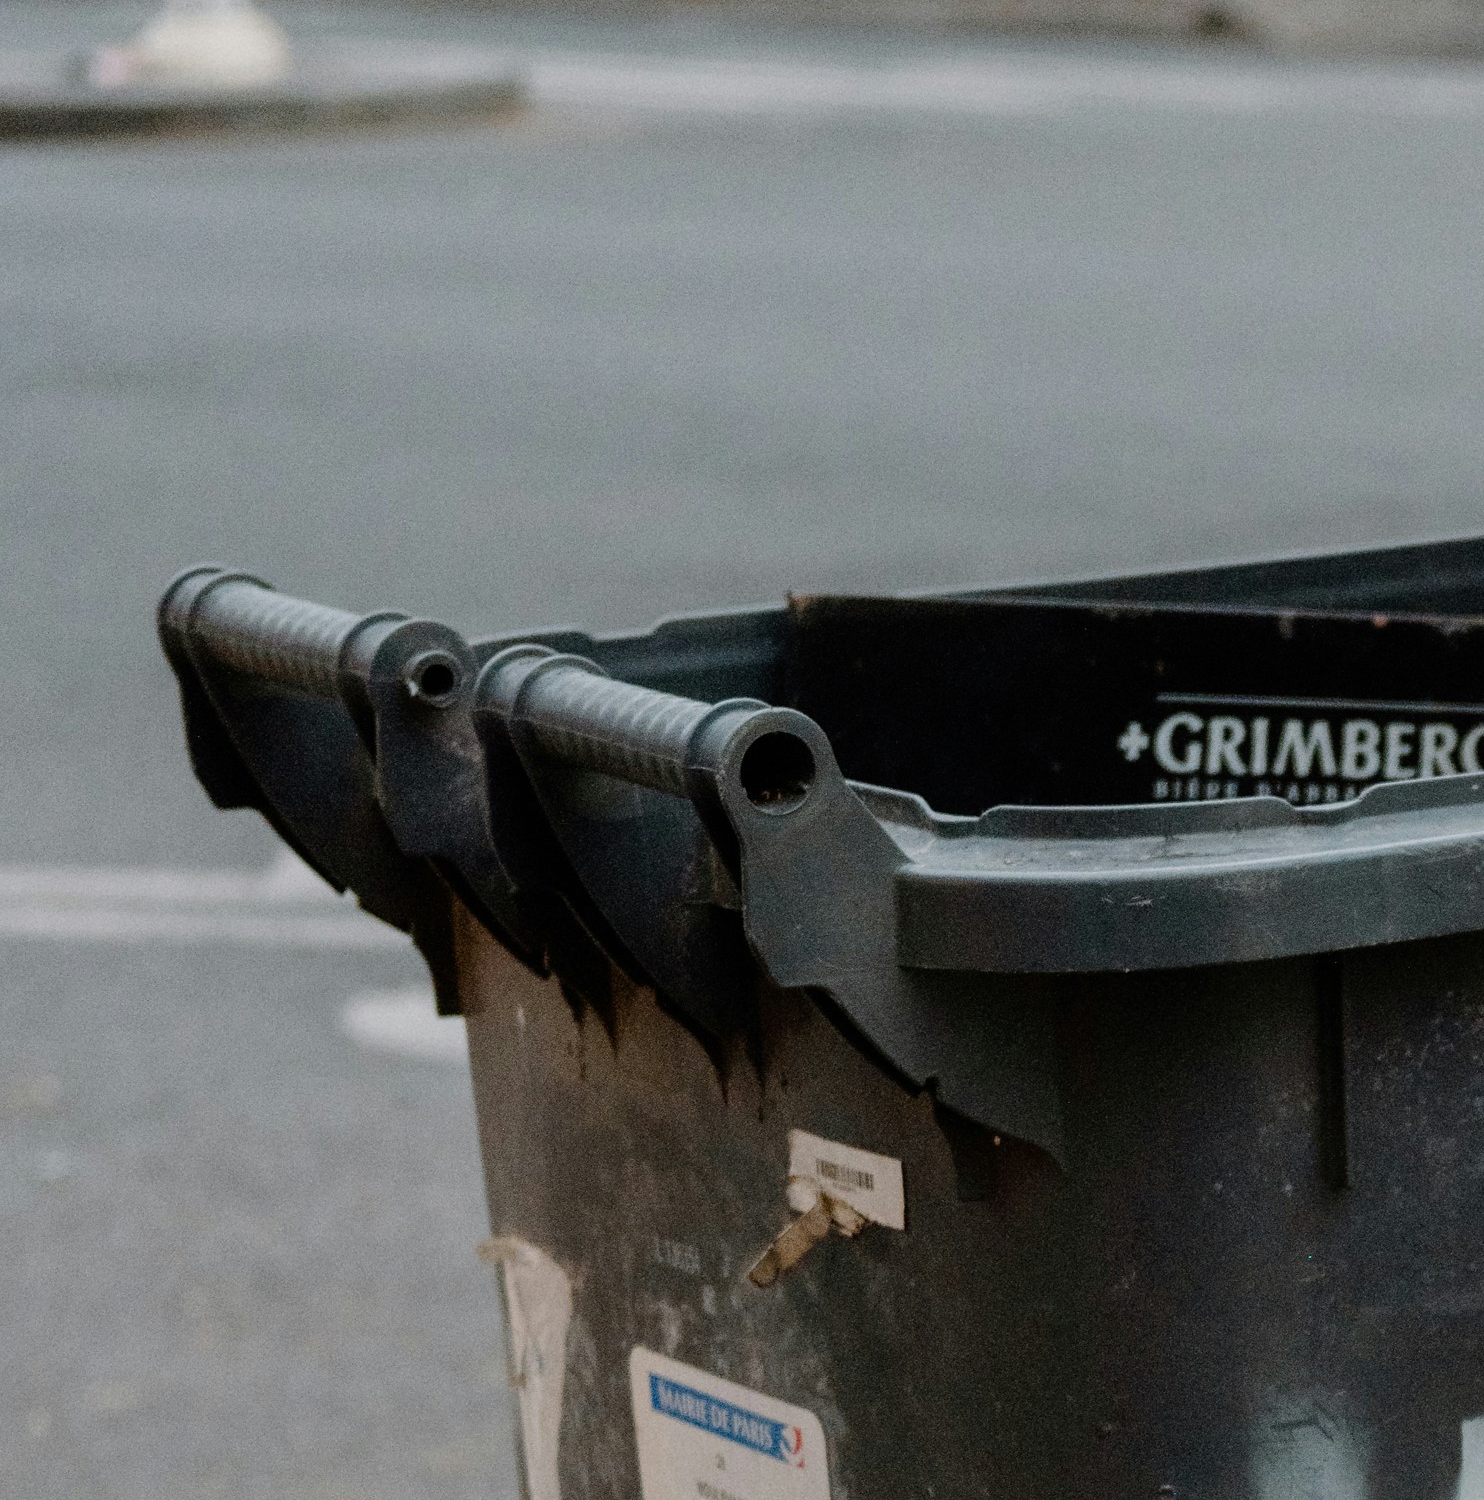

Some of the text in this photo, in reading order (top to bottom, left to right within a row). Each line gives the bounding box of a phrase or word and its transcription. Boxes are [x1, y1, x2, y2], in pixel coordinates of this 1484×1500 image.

[657, 1379, 773, 1449] MAIRIE DE PARIS
